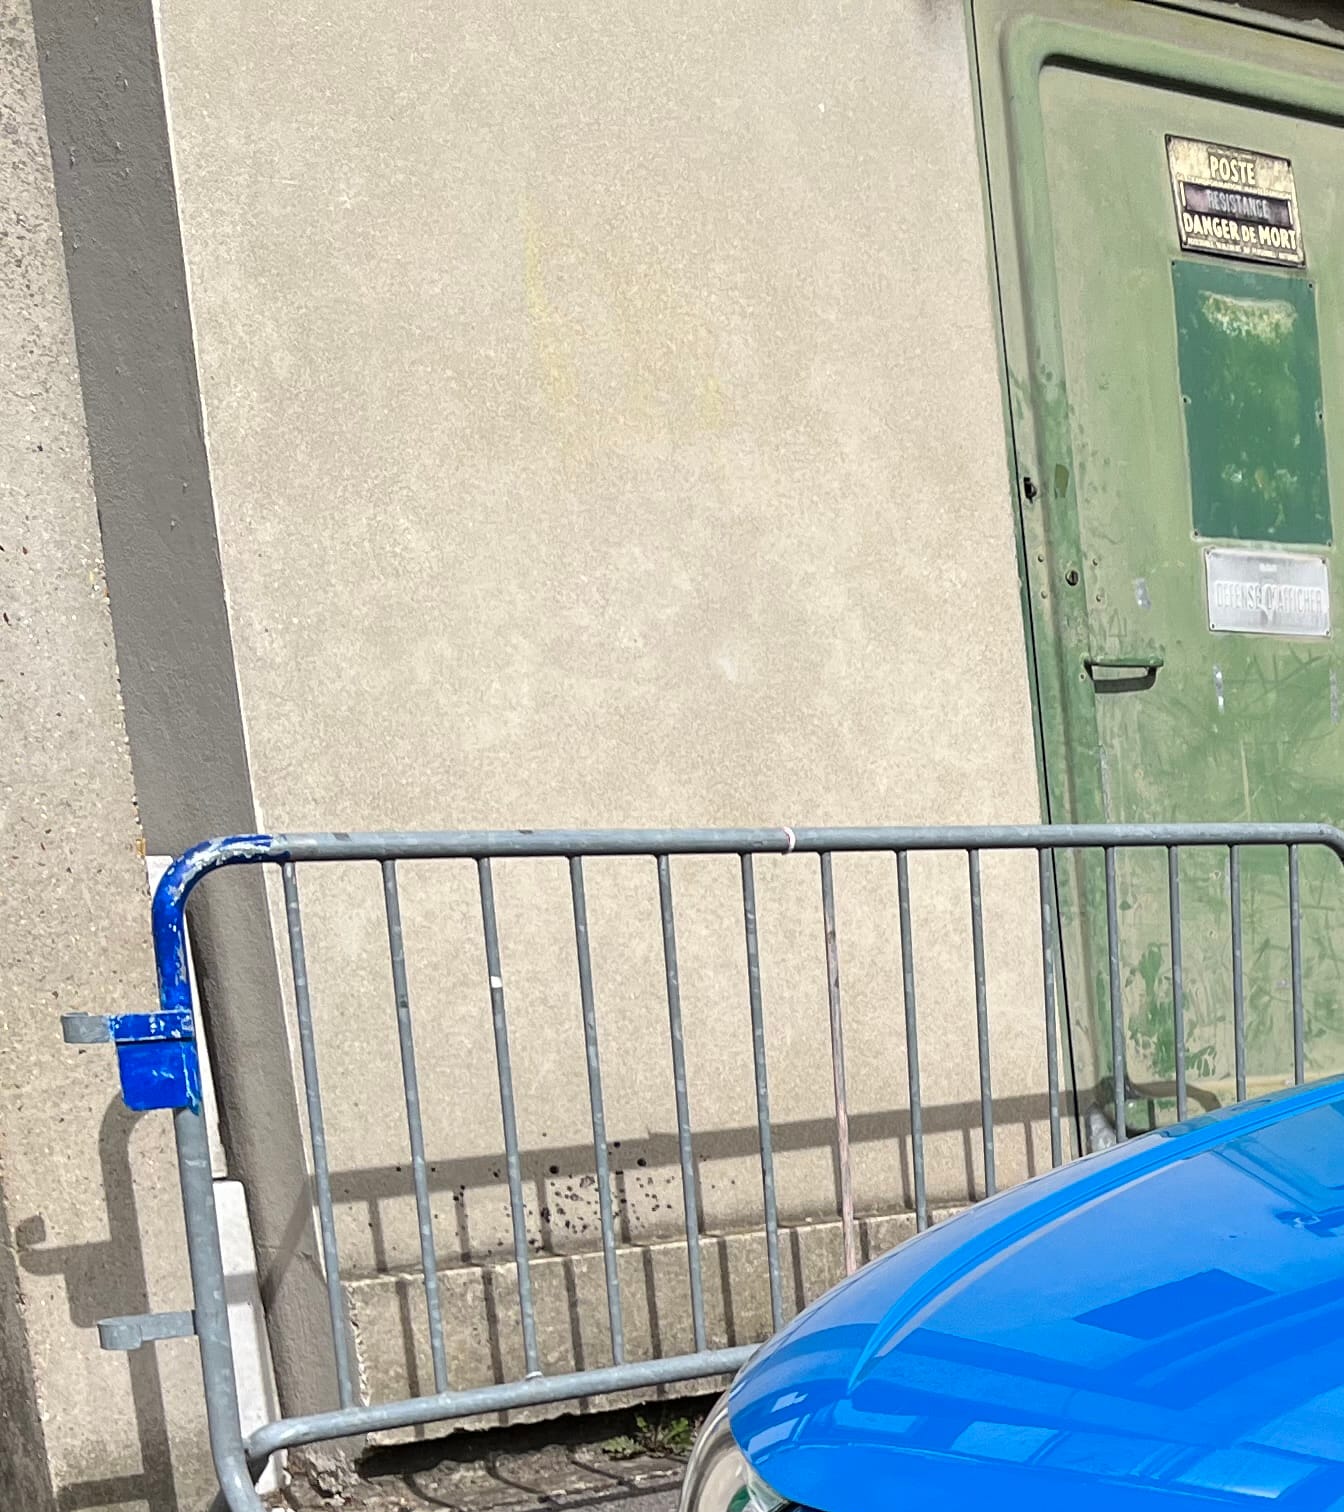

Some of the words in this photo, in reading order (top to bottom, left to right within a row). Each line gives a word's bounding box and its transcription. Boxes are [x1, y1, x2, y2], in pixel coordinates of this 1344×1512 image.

[1209, 155, 1256, 185] POSTE
[1182, 212, 1240, 241] DANGER
[1241, 225, 1257, 243] DE
[1258, 225, 1297, 250] MORT
